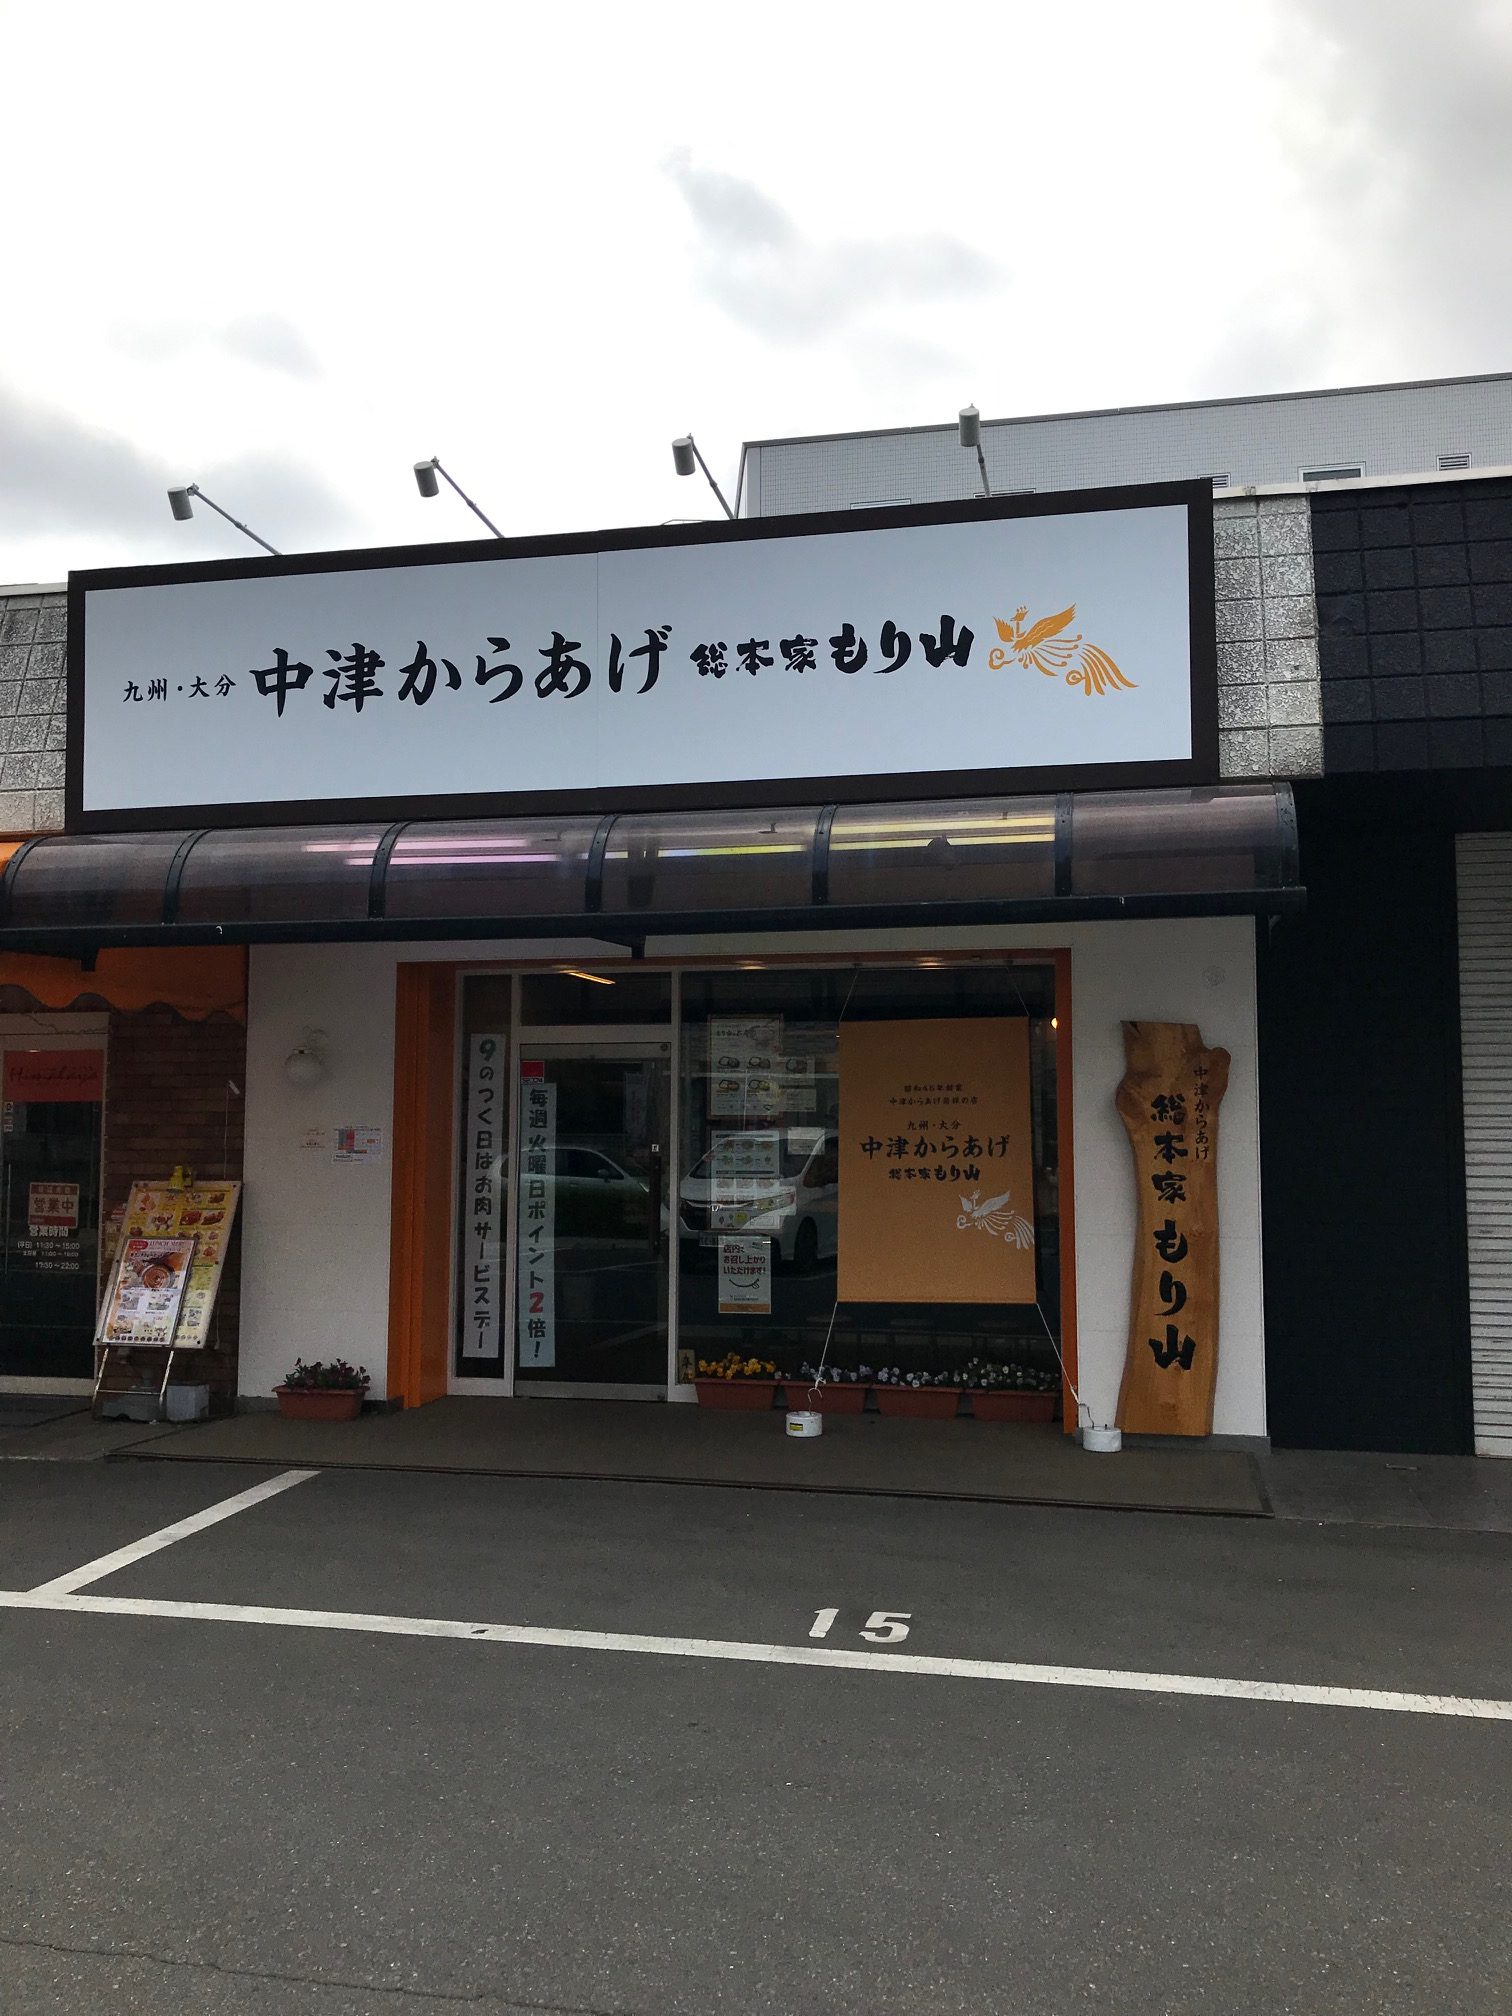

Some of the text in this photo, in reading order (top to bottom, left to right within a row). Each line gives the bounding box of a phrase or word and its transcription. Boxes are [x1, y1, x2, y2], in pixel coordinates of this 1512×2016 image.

[123, 614, 975, 717] 九州・大分 中津からあげ 総本家もり山
[907, 1120, 962, 1131] 九州・大分
[1193, 1065, 1211, 1161] 中津からあげ
[860, 1134, 1010, 1160] 中津からあげ
[888, 1164, 980, 1182] 総本家もり山
[33, 1197, 74, 1214] 営業中
[472, 1038, 496, 1349] 9のつく日はお肉サービスデー
[29, 1225, 69, 1237] 営業時間
[1148, 1093, 1197, 1371] 総本家もり山
[809, 1608, 911, 1643] 15
